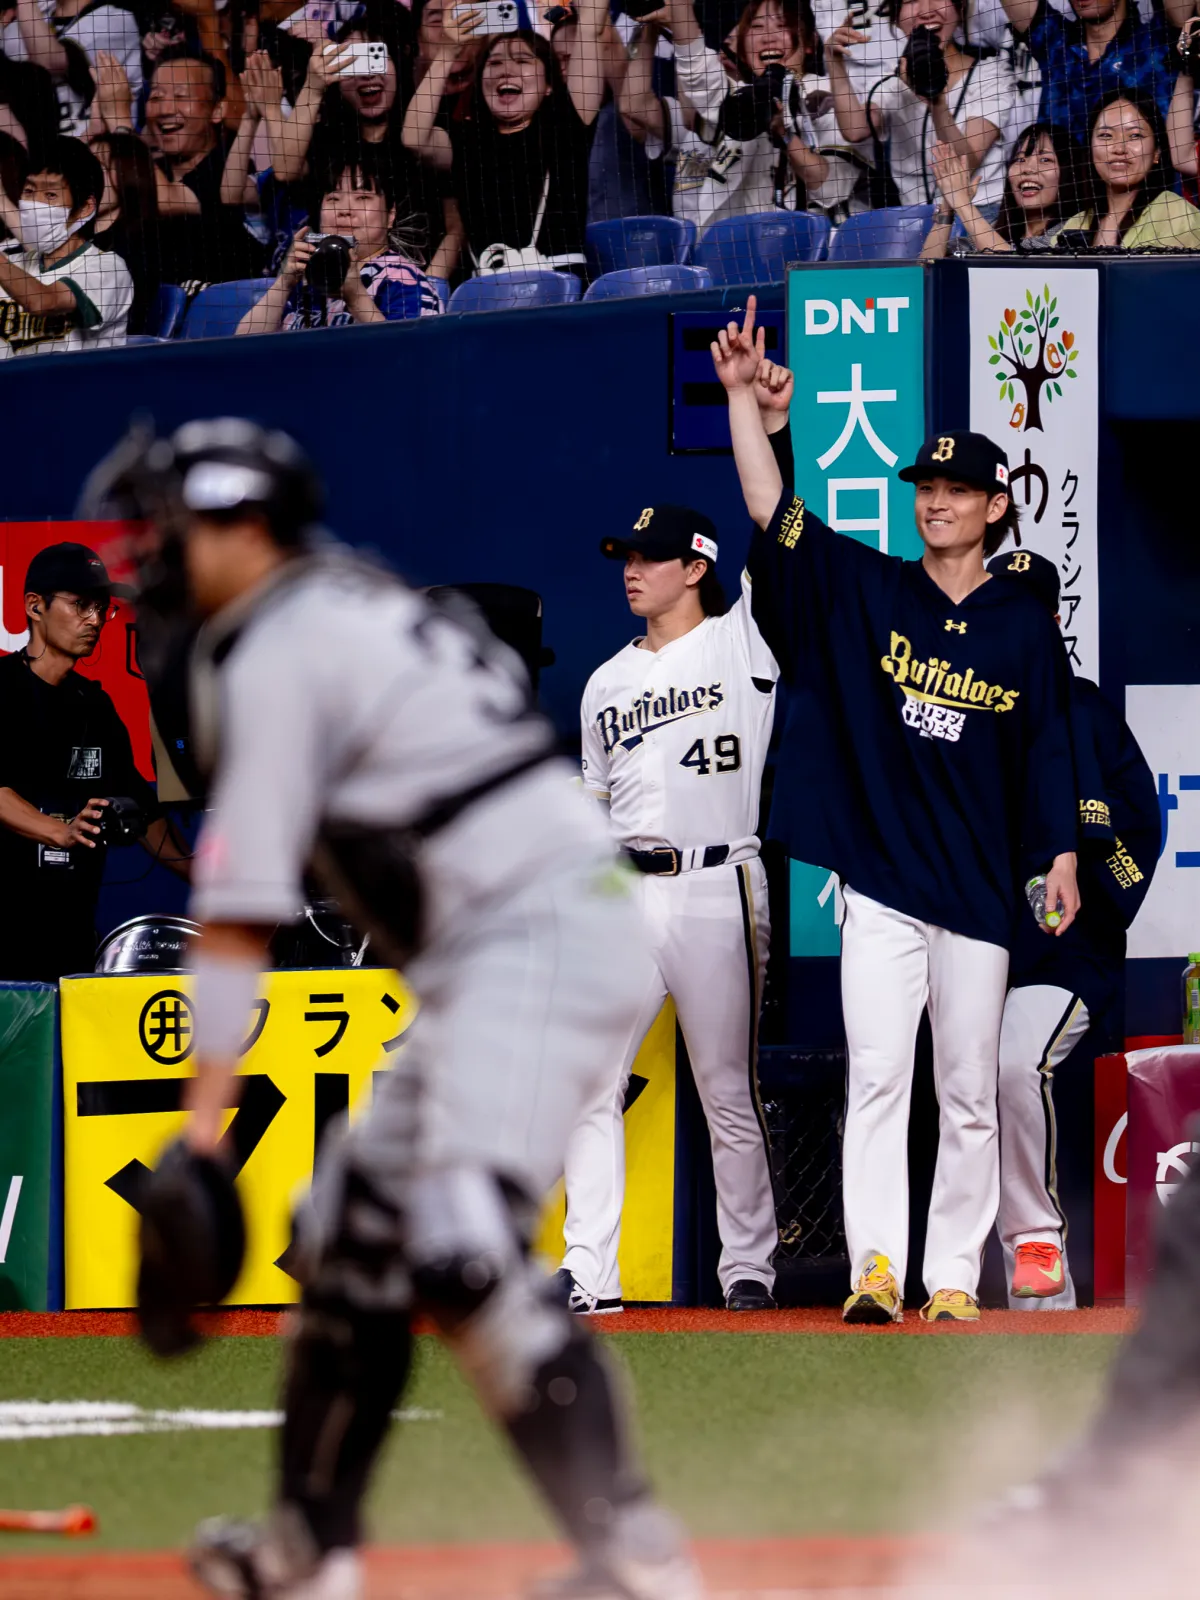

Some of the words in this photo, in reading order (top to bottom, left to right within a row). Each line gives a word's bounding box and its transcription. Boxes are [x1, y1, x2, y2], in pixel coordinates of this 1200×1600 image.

[804, 297, 909, 336] DNT
[931, 436, 956, 462] B
[633, 507, 654, 531] B
[1007, 552, 1031, 573] B
[1061, 468, 1083, 667] クラシアス
[881, 630, 1020, 713] Buffaloes
[597, 682, 725, 758] Buffaloes
[679, 733, 742, 776] 49
